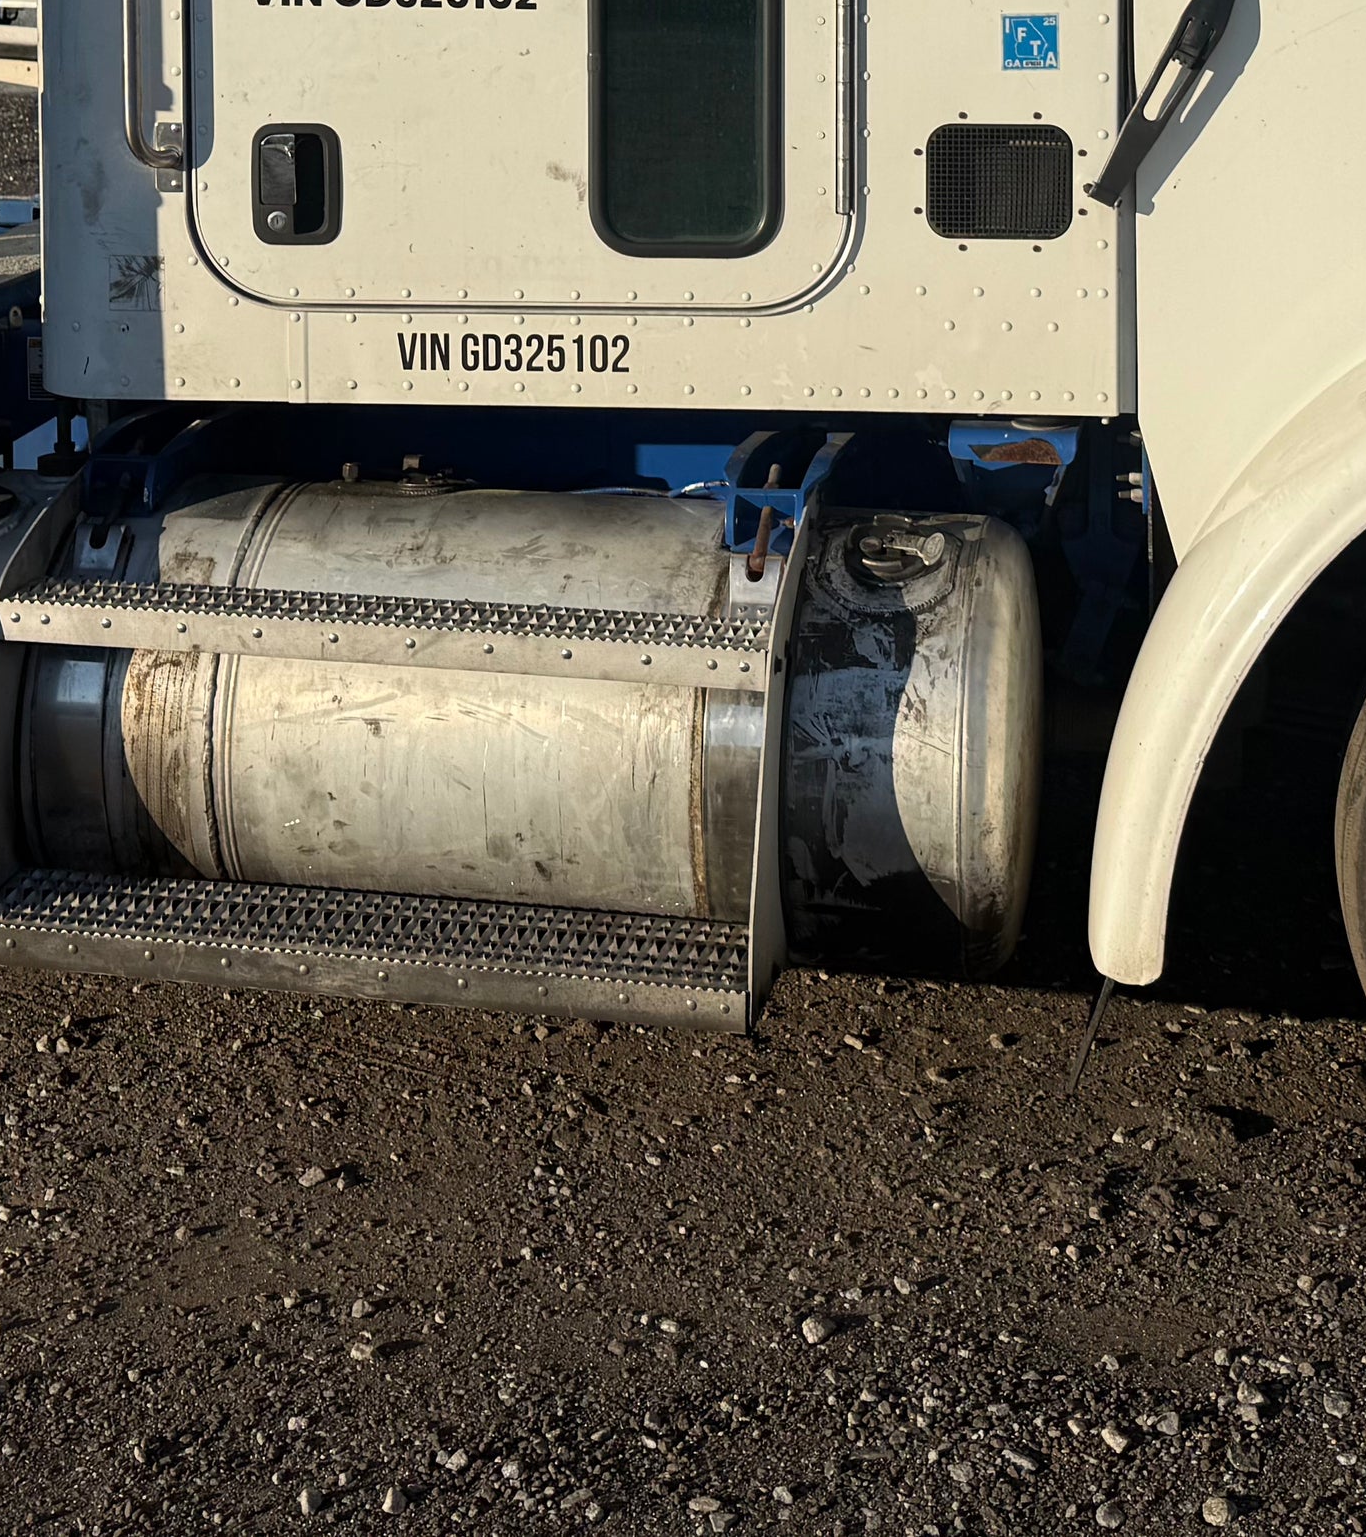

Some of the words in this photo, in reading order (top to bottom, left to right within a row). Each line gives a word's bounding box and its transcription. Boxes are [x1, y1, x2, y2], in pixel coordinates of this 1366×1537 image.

[1042, 17, 1057, 26] 25
[1004, 59, 1022, 68] GA
[397, 332, 450, 371] VIN
[461, 332, 630, 373] GD325102
